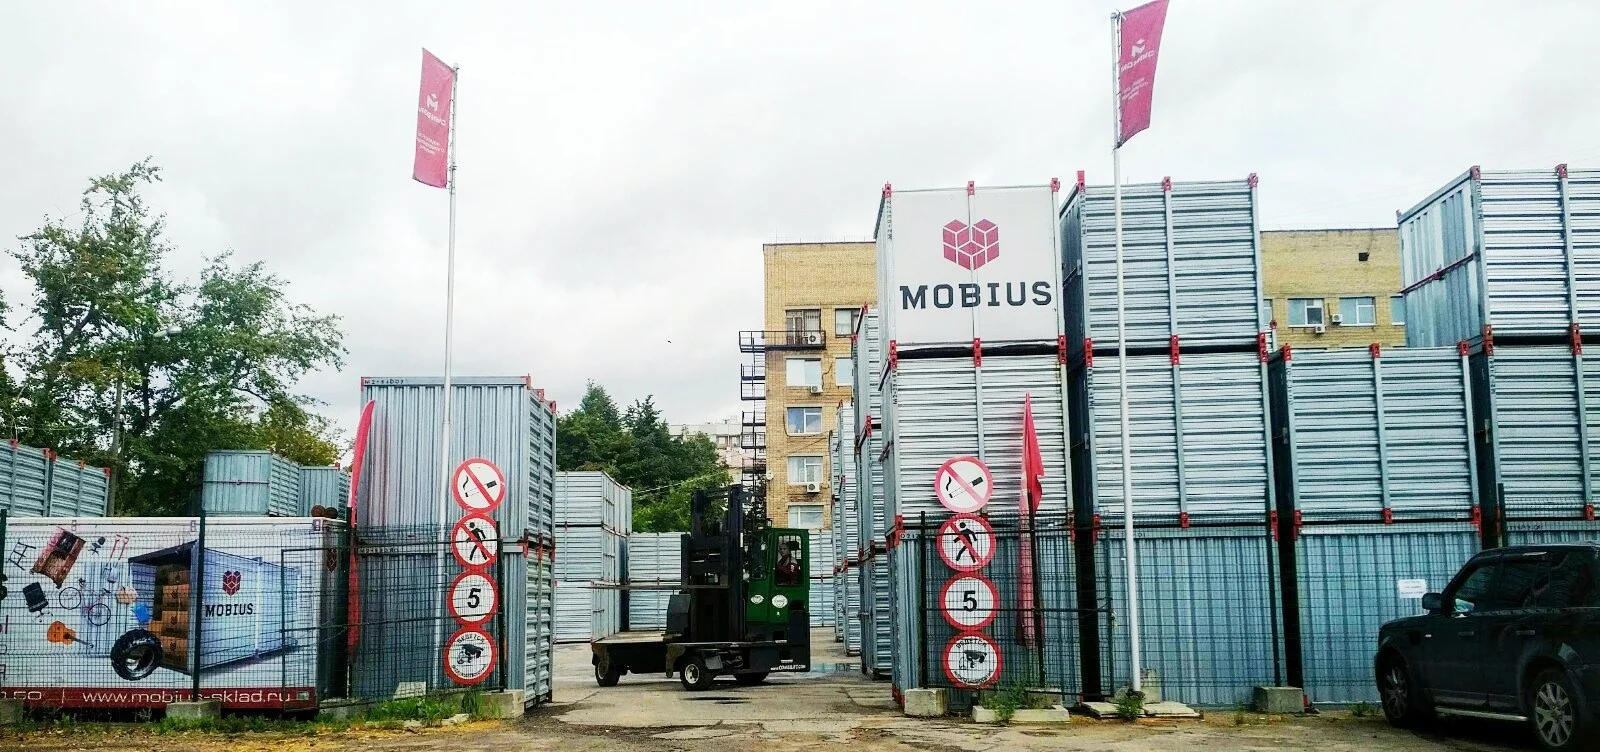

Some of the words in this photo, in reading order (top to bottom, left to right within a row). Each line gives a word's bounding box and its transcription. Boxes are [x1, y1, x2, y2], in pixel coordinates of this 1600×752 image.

[899, 281, 1052, 310] MOBIUS
[467, 587, 481, 608] 5
[963, 590, 977, 612] 5
[205, 603, 253, 617] MOBIUS
